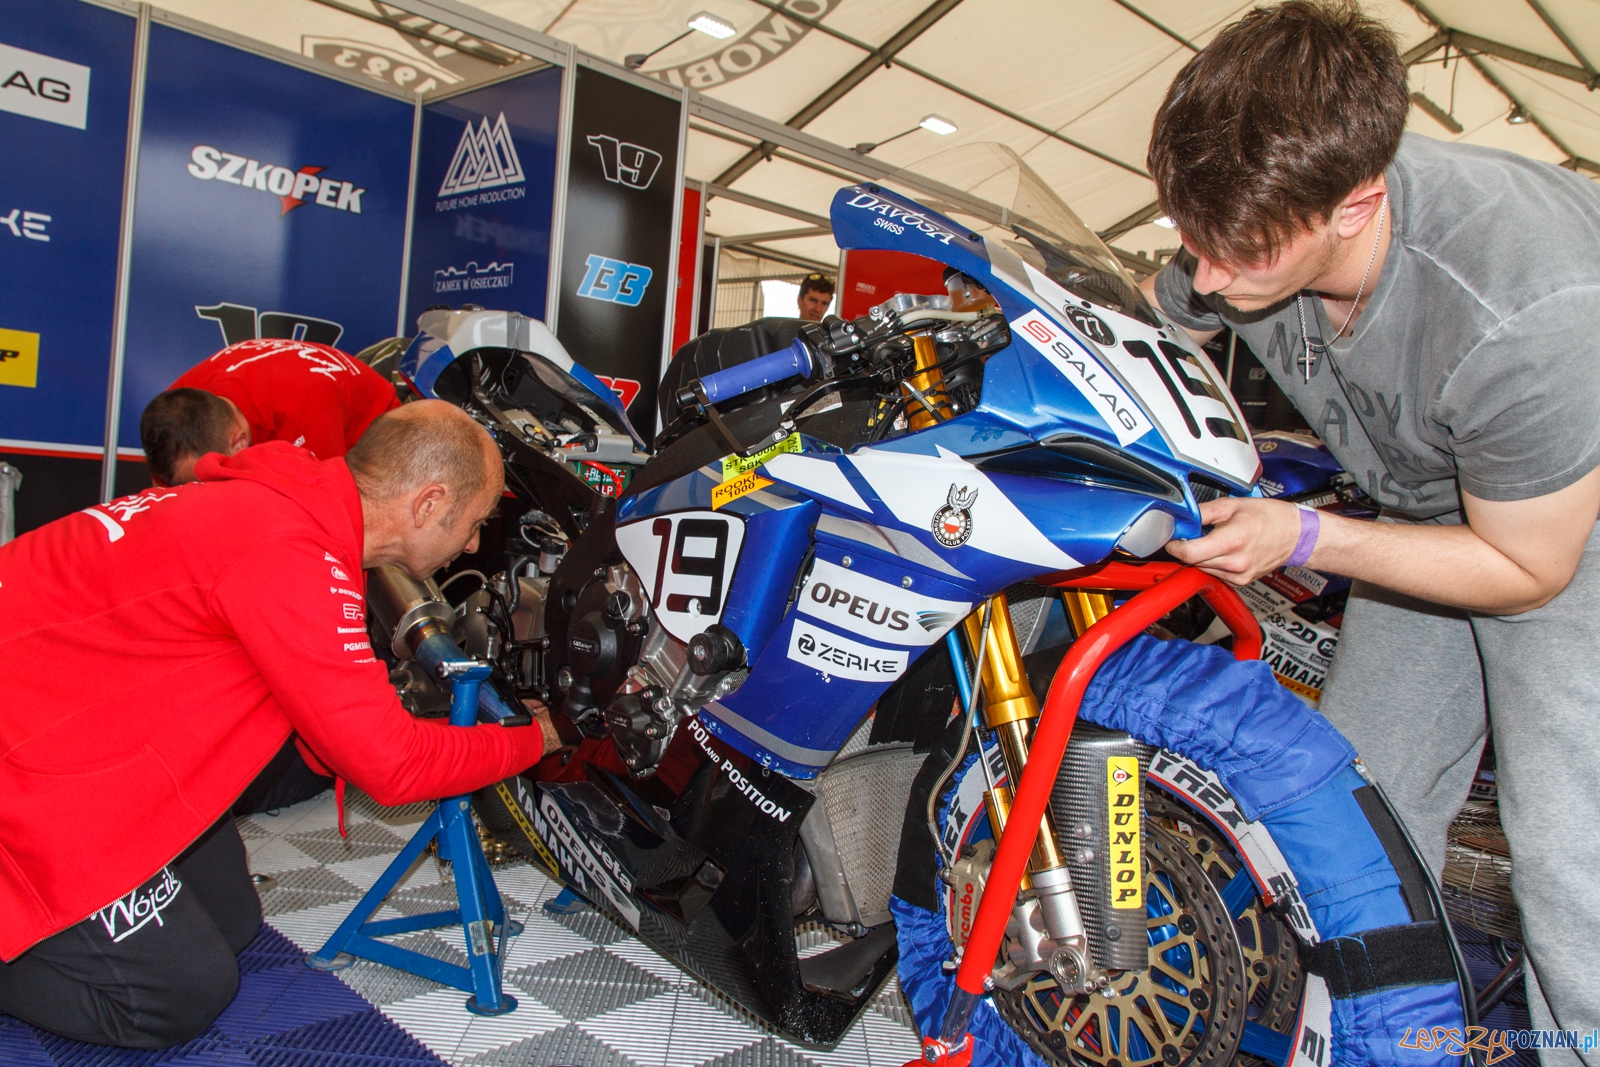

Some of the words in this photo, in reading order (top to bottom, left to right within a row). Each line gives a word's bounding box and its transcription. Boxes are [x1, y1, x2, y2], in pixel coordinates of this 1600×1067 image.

[188, 145, 366, 214] SZKOPEK
[586, 134, 663, 190] 19
[435, 198, 458, 212] FUTURE
[458, 195, 478, 208] HOME
[479, 187, 526, 204] PRODUCTION
[873, 217, 905, 235] SWISS
[436, 279, 461, 292] ZAMEK
[470, 275, 510, 290] OSIECZKU
[576, 253, 653, 307] 133
[1051, 342, 1137, 432] SALAG
[1122, 339, 1251, 445] 19
[727, 482, 755, 498] 1000
[739, 459, 764, 474] SBK
[934, 511, 961, 545] AUTOMOBILKLUB
[961, 518, 972, 541] POLSKI
[646, 518, 730, 616] 19
[1299, 568, 1324, 589] JANIK
[810, 582, 910, 631] OPEUS
[1286, 621, 1318, 645] 2D
[817, 642, 899, 673] ZERKE
[1261, 645, 1326, 690] YAMAH
[1270, 641, 1285, 653] BIKE
[1285, 651, 1325, 675] PROMOTION
[720, 759, 792, 823] POSITION
[516, 775, 588, 893] YAMAHA
[546, 803, 606, 889] OPEUS
[1112, 793, 1138, 902] DUNLOP
